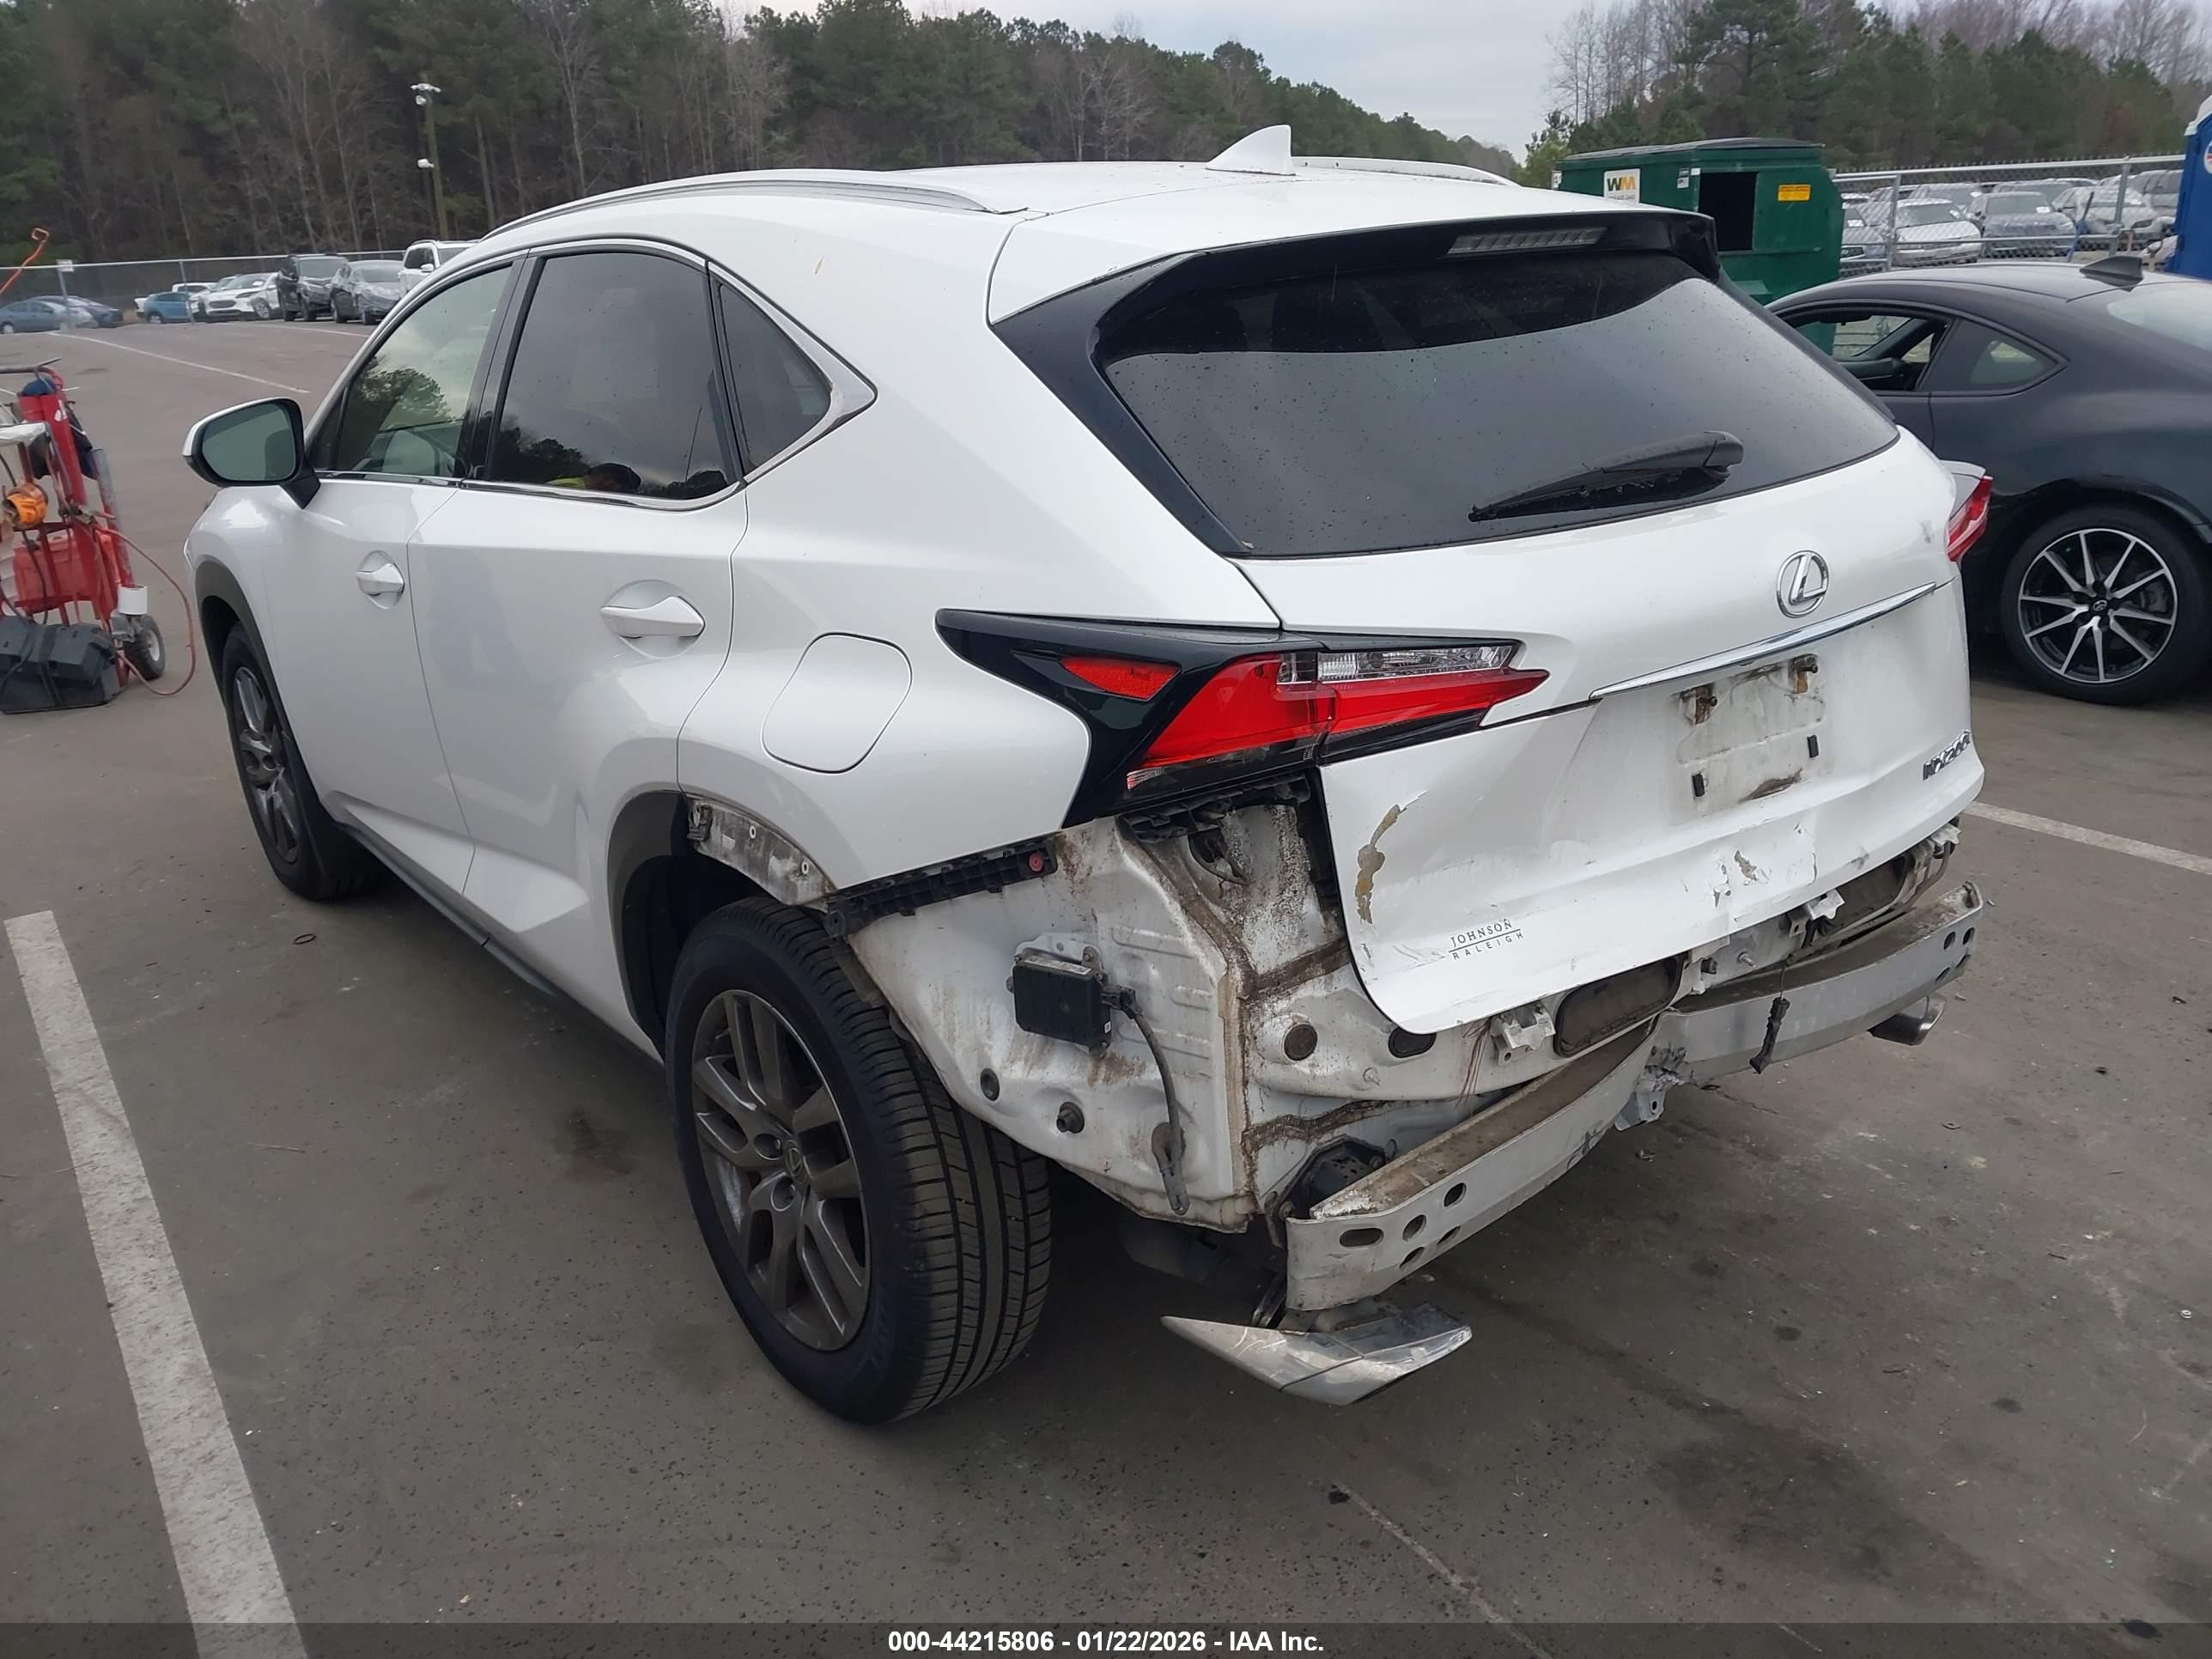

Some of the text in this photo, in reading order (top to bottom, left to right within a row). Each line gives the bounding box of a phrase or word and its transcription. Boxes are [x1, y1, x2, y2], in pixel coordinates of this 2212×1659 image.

[1607, 176, 1636, 191] WM
[1451, 918, 1512, 948] JOHNSON
[1452, 932, 1524, 960] RALEIGH
